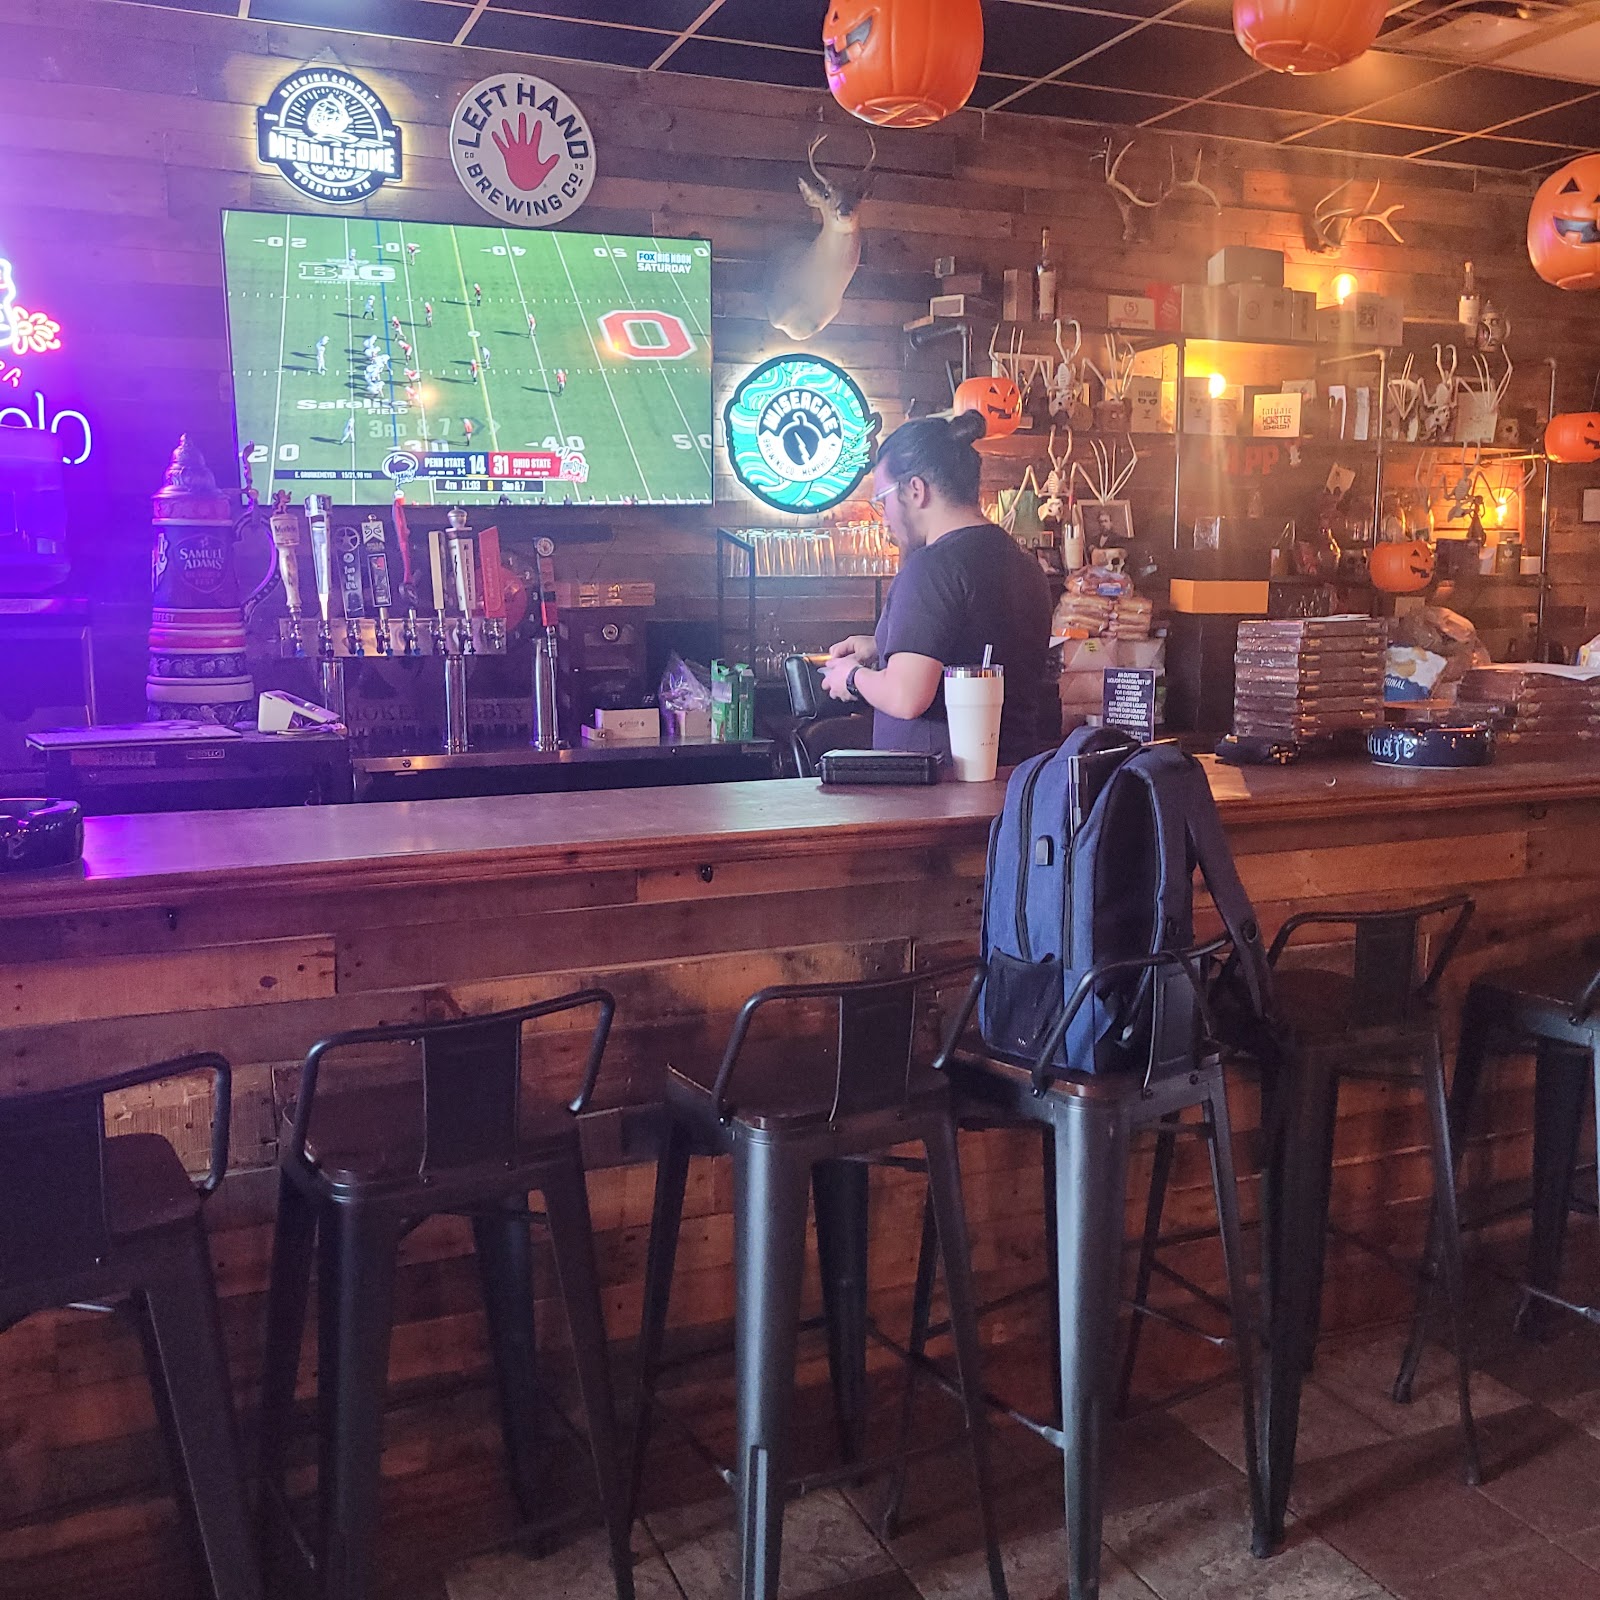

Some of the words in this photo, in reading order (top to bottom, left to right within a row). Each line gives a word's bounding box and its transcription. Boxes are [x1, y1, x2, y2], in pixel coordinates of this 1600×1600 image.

[458, 84, 508, 148] LEFT
[517, 83, 589, 159] HAND
[269, 130, 395, 174] MEDDLESOME
[467, 163, 563, 216] BREWING
[637, 251, 656, 262] FOX
[637, 262, 692, 273] SATURDAY
[763, 391, 838, 434] WISEACRE
[438, 418, 450, 436] 7
[424, 457, 444, 468] PENN
[444, 458, 466, 468] STATE
[469, 455, 487, 475] 14
[493, 455, 510, 475] 31
[512, 459, 530, 469] OHIO
[531, 459, 551, 469] STATE
[180, 548, 224, 560] SAMUEL
[184, 558, 222, 571] ADAMS
